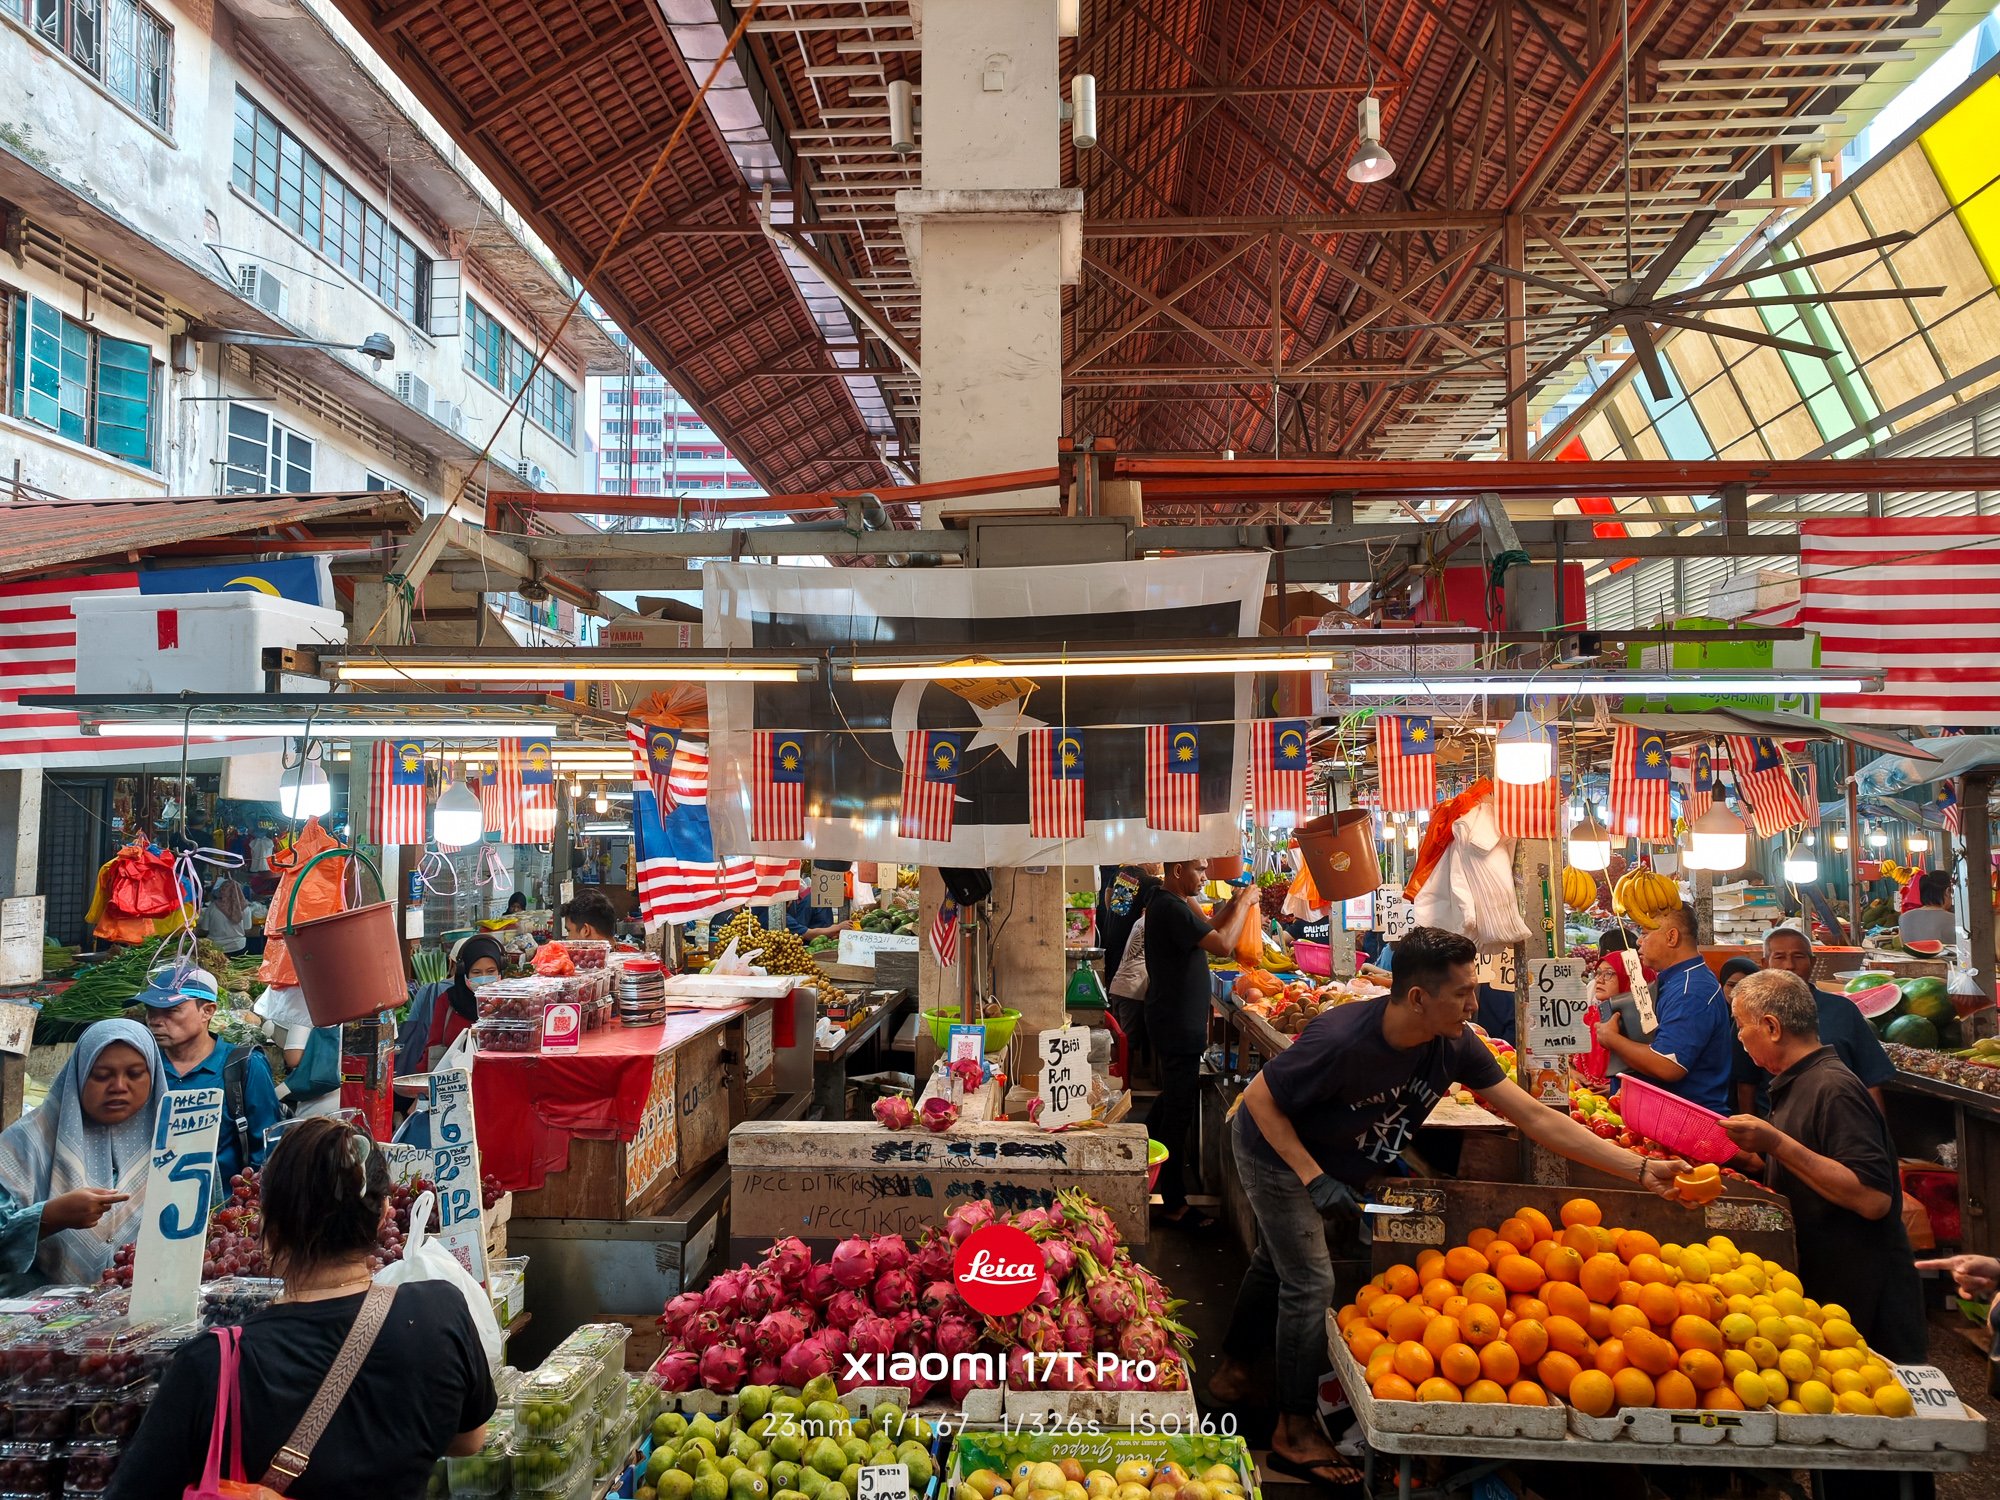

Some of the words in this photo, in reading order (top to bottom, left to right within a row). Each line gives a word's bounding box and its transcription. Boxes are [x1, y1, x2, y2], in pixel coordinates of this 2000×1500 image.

[610, 631, 644, 641] YAMAHA
[1386, 896, 1393, 909] 5
[1406, 909, 1415, 924] 6
[1500, 966, 1515, 985] 10
[1538, 963, 1554, 993] 6
[1048, 1038, 1062, 1066] 3
[437, 1072, 461, 1084] PAKET
[173, 1091, 217, 1107] PAKET
[440, 1104, 461, 1143] 6
[434, 1150, 460, 1183] 2
[159, 1152, 213, 1240] 5
[441, 1189, 480, 1227] 12
[1897, 1370, 1921, 1385] 10
[861, 1469, 875, 1491] 5
